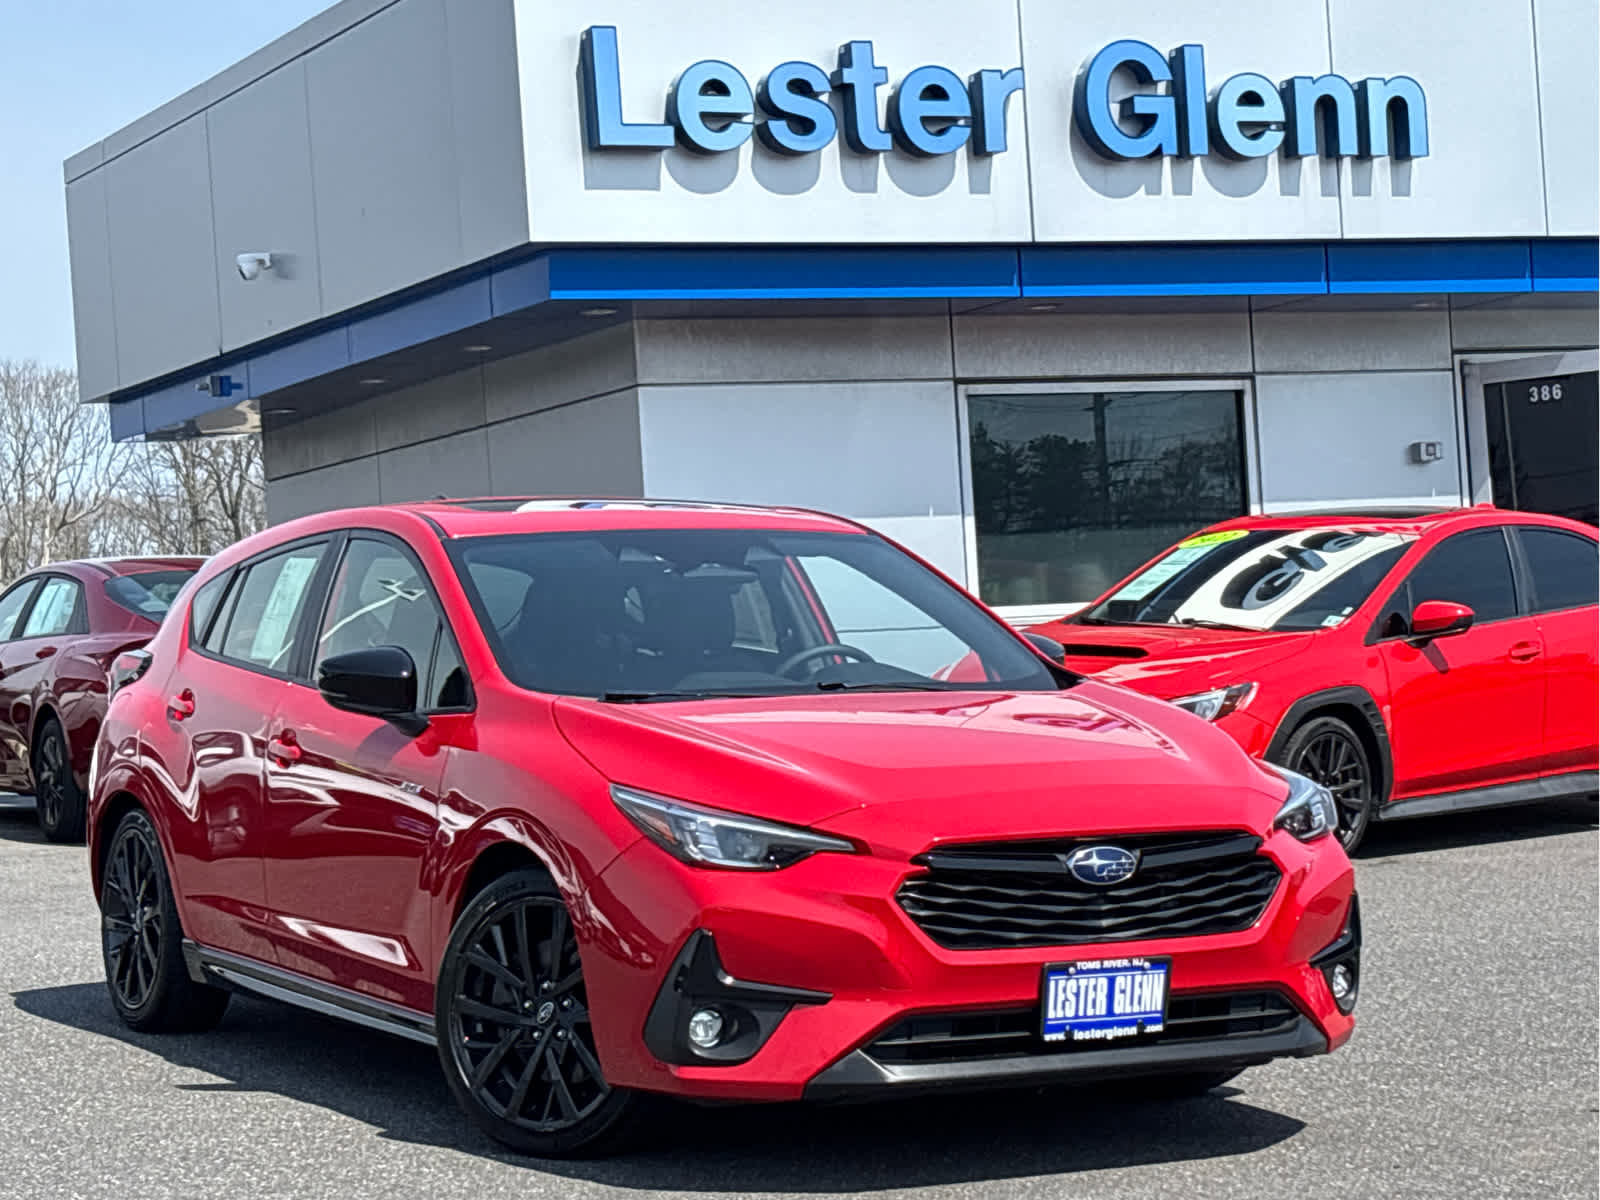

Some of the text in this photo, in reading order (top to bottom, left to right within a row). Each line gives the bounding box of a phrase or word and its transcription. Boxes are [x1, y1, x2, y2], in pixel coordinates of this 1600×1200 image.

[581, 26, 1429, 160] Lester Glenn
[1529, 384, 1562, 403] 386
[1076, 961, 1101, 970] TOMS
[1132, 957, 1144, 967] NJ
[1047, 974, 1164, 1018] LESTER GLENN
[1073, 1025, 1137, 1040] lesterglenn
